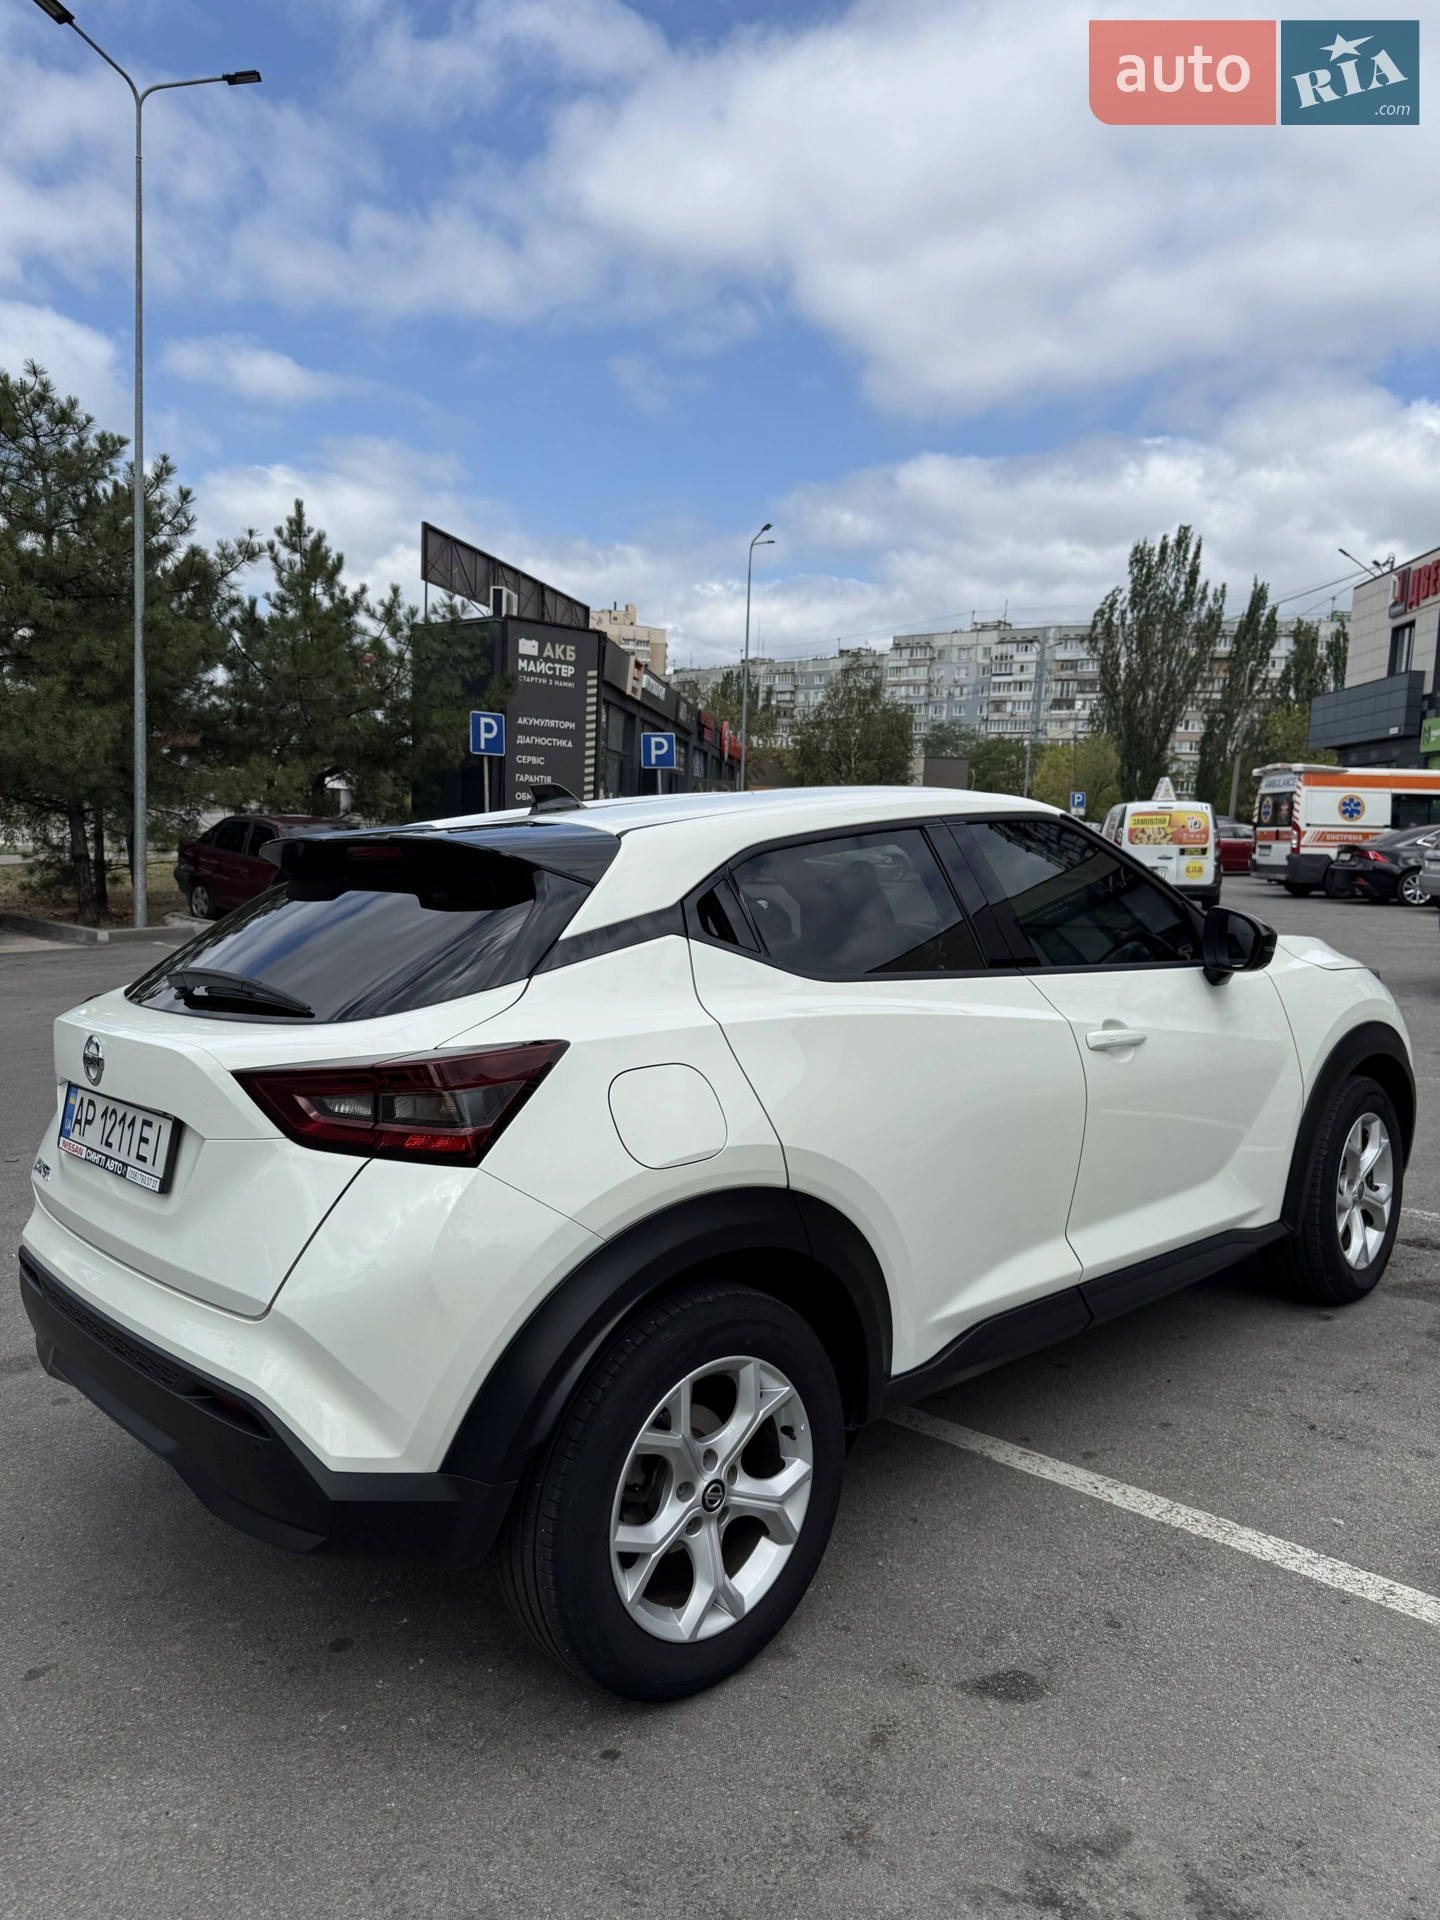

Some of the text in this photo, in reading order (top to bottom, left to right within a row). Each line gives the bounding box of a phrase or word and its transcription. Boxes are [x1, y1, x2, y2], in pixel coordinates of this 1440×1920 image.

[1407, 561, 1440, 609] ДВЕ
[543, 642, 576, 661] АКБ
[518, 658, 575, 677] МАЙСТЕР
[518, 675, 547, 685] СТАРТУЙ
[517, 716, 576, 730] АКУМУЛЯТОРИ
[516, 735, 573, 748] ДІАГНОСТИКА
[516, 755, 545, 765] СЕРВІС
[515, 773, 552, 783] ГАРАНТІЯ
[1264, 776, 1297, 789] AMBULANCE
[515, 792, 532, 801] ОБМ
[1326, 833, 1363, 842] ЕКСТРЕНА
[61, 1140, 84, 1157] NISSAN
[85, 1149, 122, 1175] СИНГЛ АВТО
